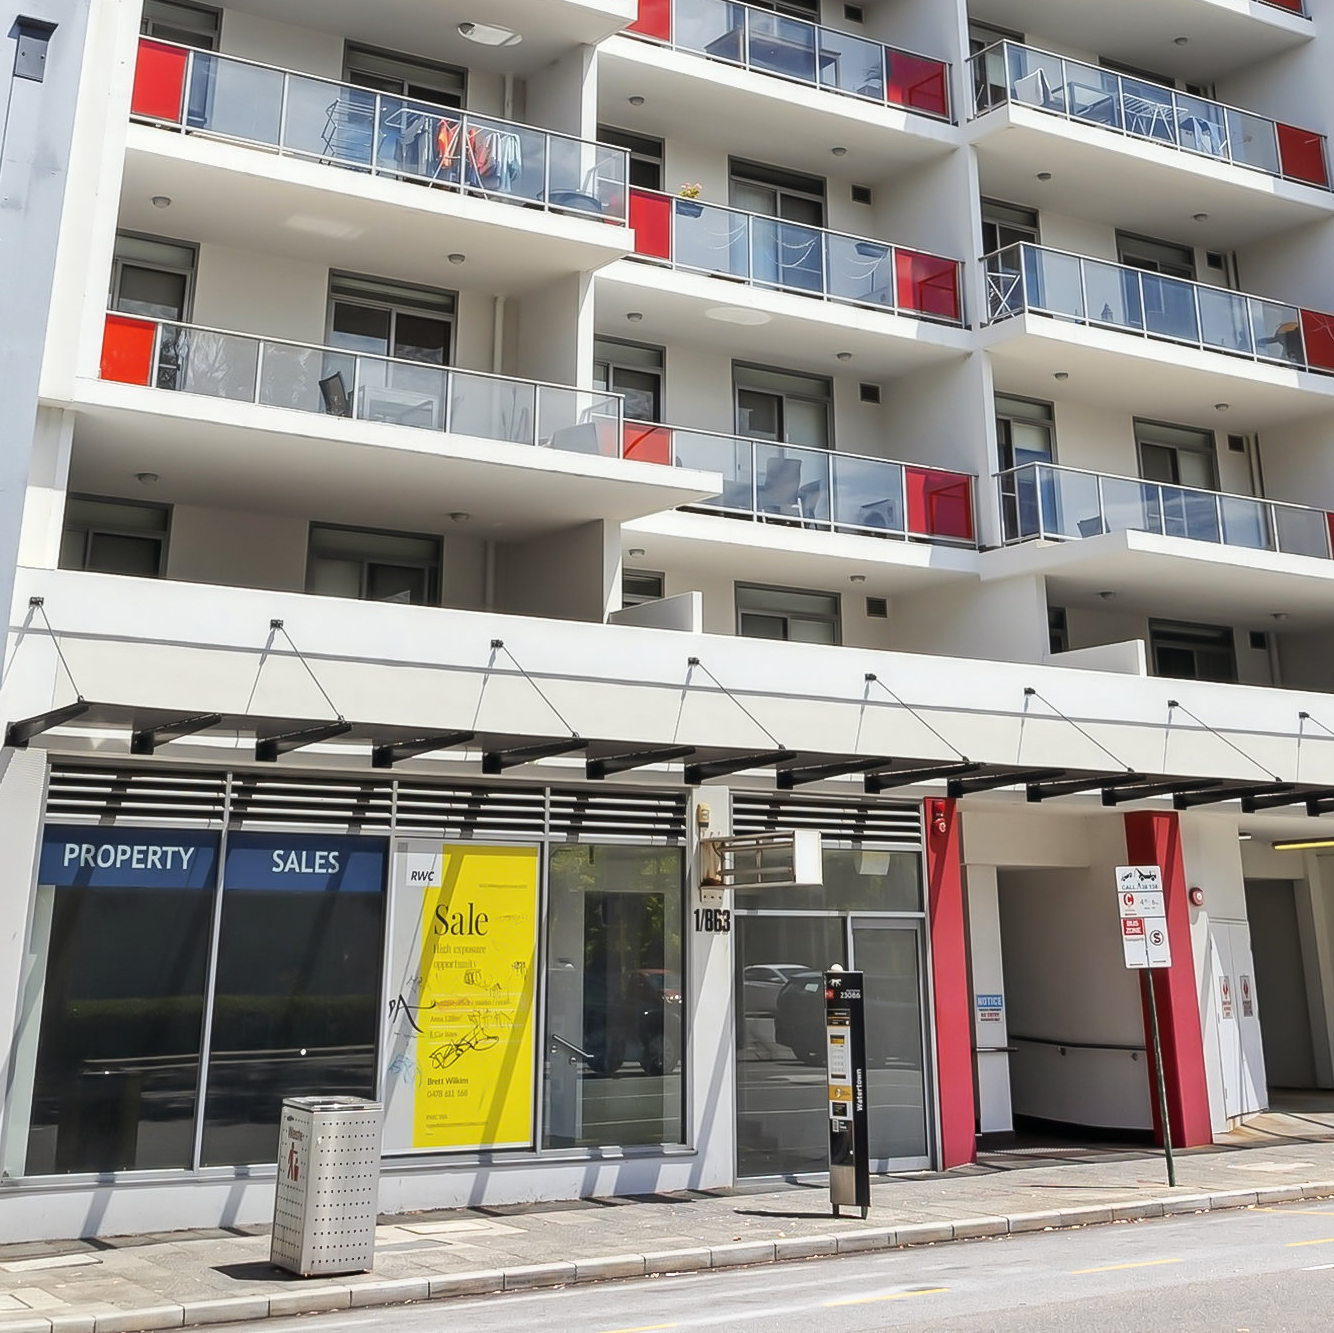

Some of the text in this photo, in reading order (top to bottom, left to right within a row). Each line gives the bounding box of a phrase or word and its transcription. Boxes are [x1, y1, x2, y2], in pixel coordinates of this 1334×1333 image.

[63, 843, 340, 874] PROPERTY SALES
[410, 870, 435, 882] RWC
[434, 902, 489, 936] Sale
[694, 908, 731, 932] 1/863
[1153, 932, 1161, 944] S
[977, 996, 1002, 1006] NOTICE
[427, 1077, 444, 1086] Brett
[856, 1068, 864, 1112] Watertown
